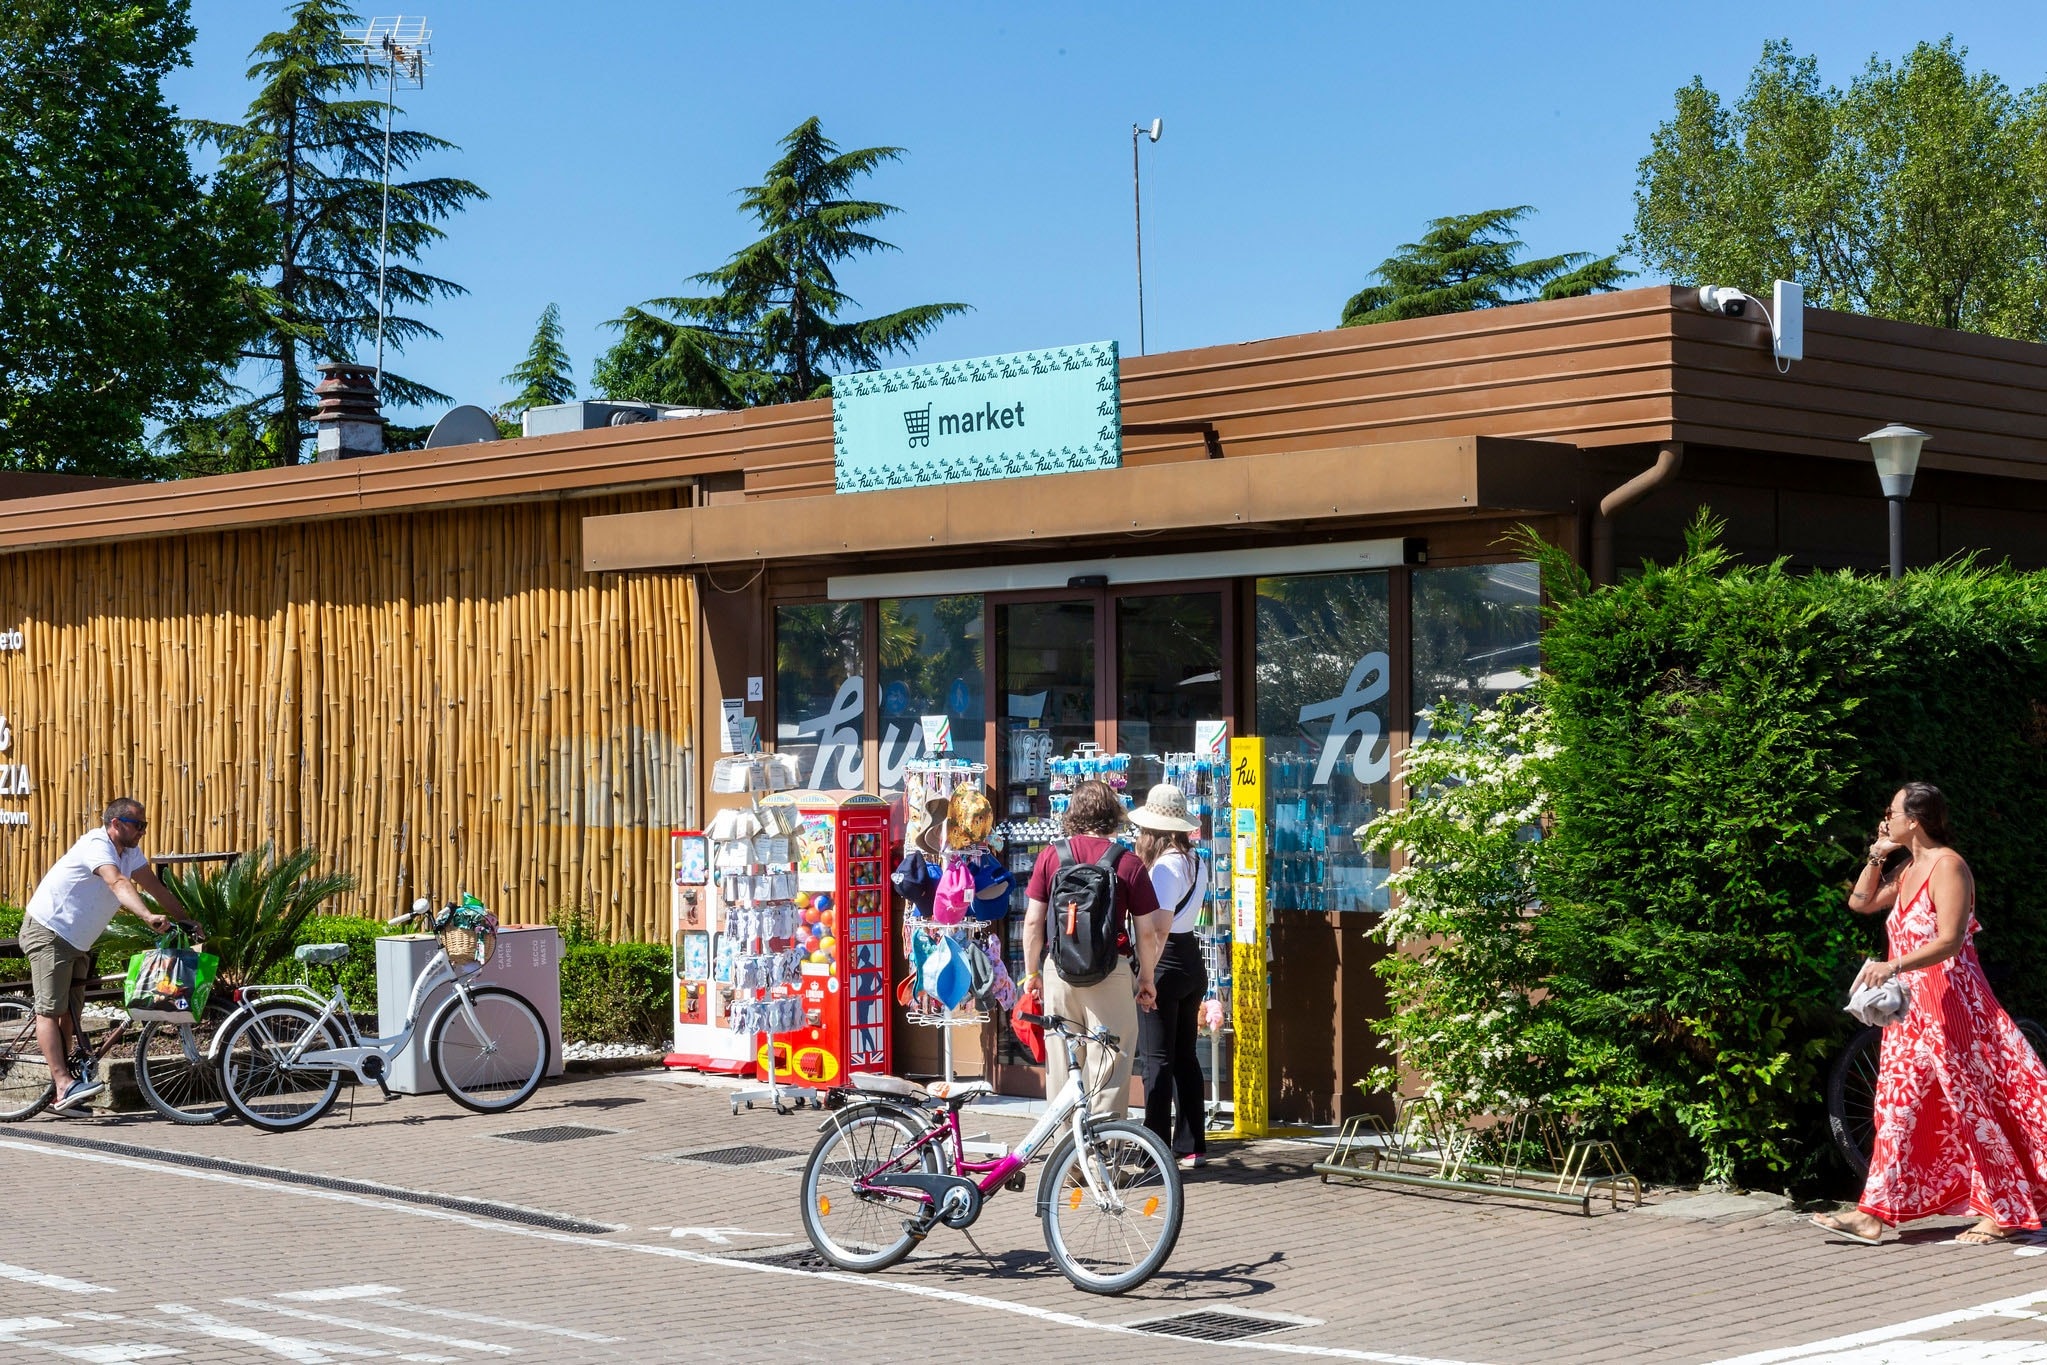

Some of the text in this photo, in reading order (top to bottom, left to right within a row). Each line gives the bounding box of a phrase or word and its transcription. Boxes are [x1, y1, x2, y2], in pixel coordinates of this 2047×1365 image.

[855, 383, 870, 397] hu
[883, 379, 898, 393] hu
[911, 375, 927, 390] hu
[940, 371, 956, 386] hu
[970, 367, 986, 383] hu
[1000, 364, 1017, 379] hu
[1031, 360, 1048, 375] hu
[1063, 356, 1080, 371] hu
[1095, 352, 1112, 367] hu
[1096, 376, 1113, 392] hu
[1096, 401, 1114, 416] hu
[938, 401, 1025, 435] market
[1097, 426, 1115, 441] hu
[858, 474, 873, 488] hu
[886, 471, 901, 486] hu
[915, 468, 931, 483] hu
[944, 465, 960, 480] hu
[974, 463, 990, 478] hu
[1004, 460, 1021, 475] hu
[1035, 456, 1052, 472] hu
[1066, 453, 1084, 469] hu
[1098, 450, 1116, 465] hu
[754, 682, 760, 695] 2
[798, 675, 924, 789] hu
[1235, 757, 1256, 786] hu
[849, 795, 878, 803] TELEPHONE
[0, 808, 28, 824] town
